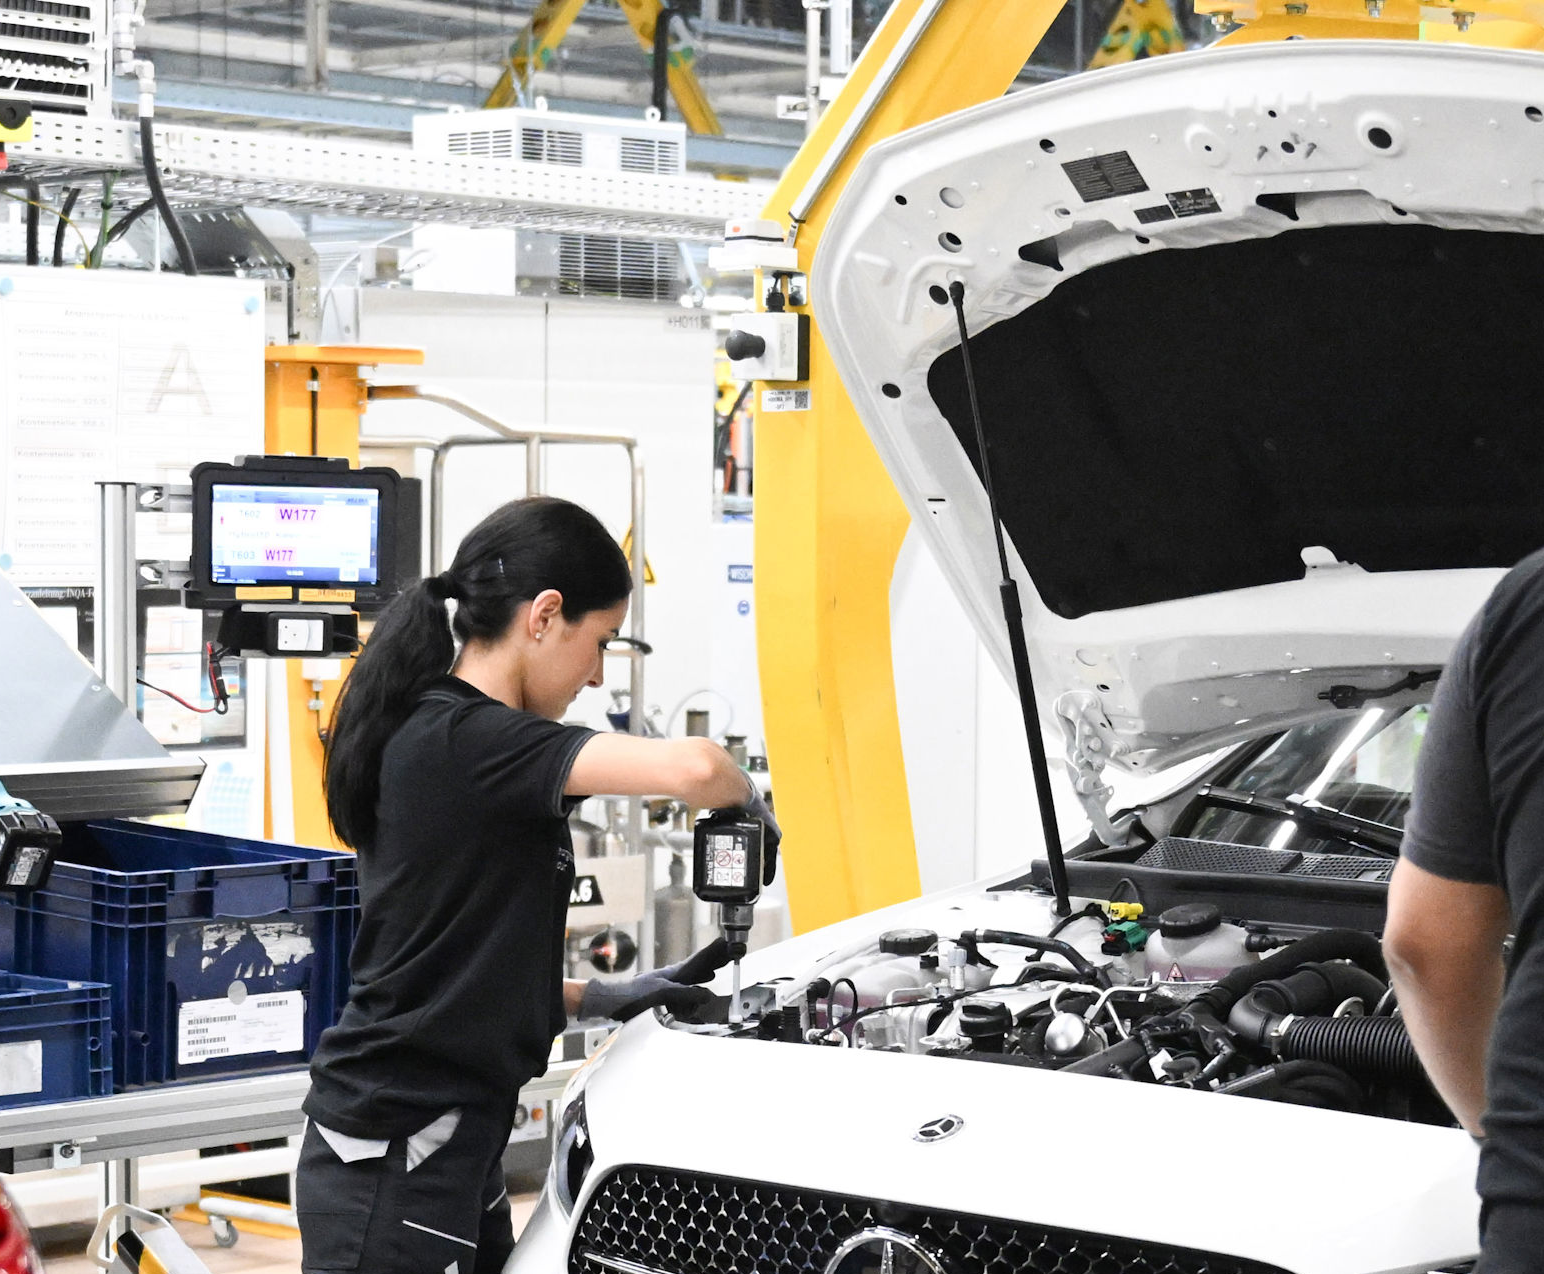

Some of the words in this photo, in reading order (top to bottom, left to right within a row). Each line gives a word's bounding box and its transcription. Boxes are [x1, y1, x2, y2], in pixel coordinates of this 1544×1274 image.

[279, 508, 317, 521] W177
[231, 550, 256, 560] T603
[265, 549, 293, 561] W177
